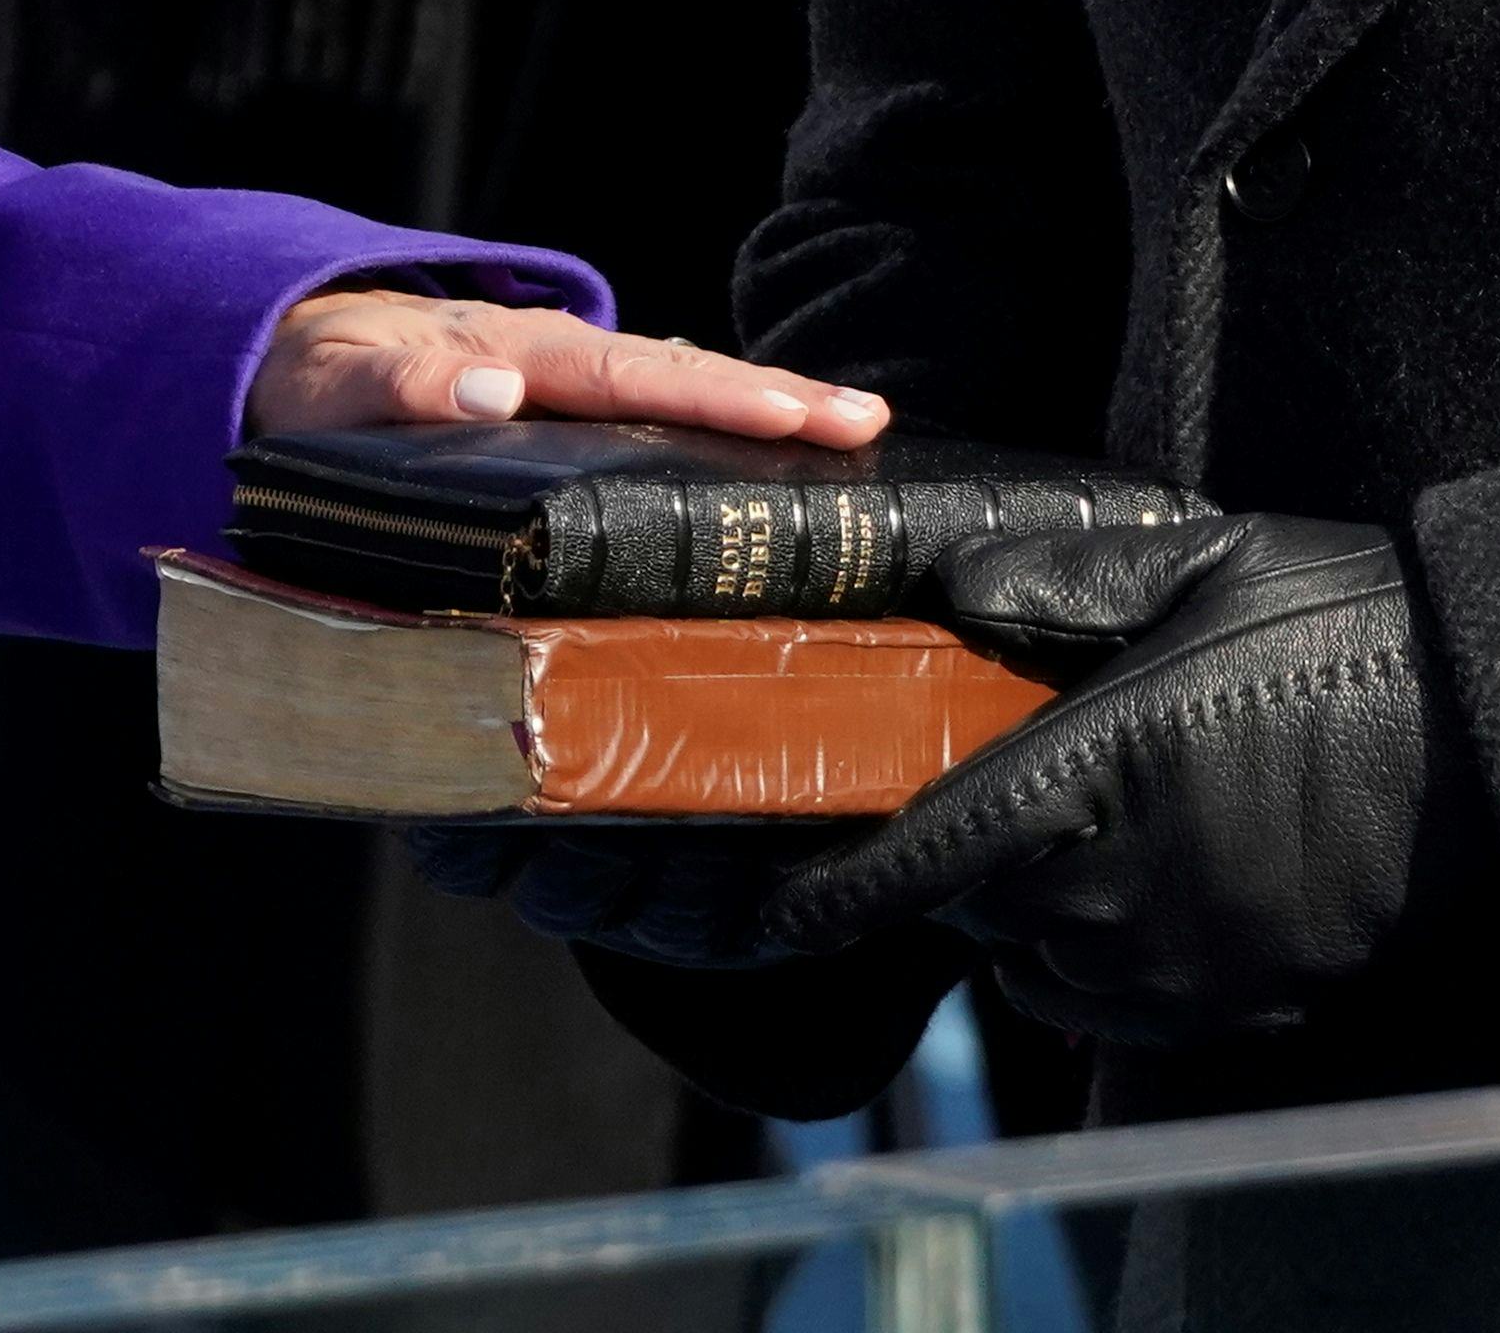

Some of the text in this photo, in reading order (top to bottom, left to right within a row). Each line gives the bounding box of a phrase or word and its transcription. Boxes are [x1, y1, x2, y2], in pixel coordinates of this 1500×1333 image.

[715, 503, 743, 595] HOLY
[743, 501, 771, 598] BIBLE
[837, 493, 853, 564] LETTER
[854, 512, 873, 589] EDITION
